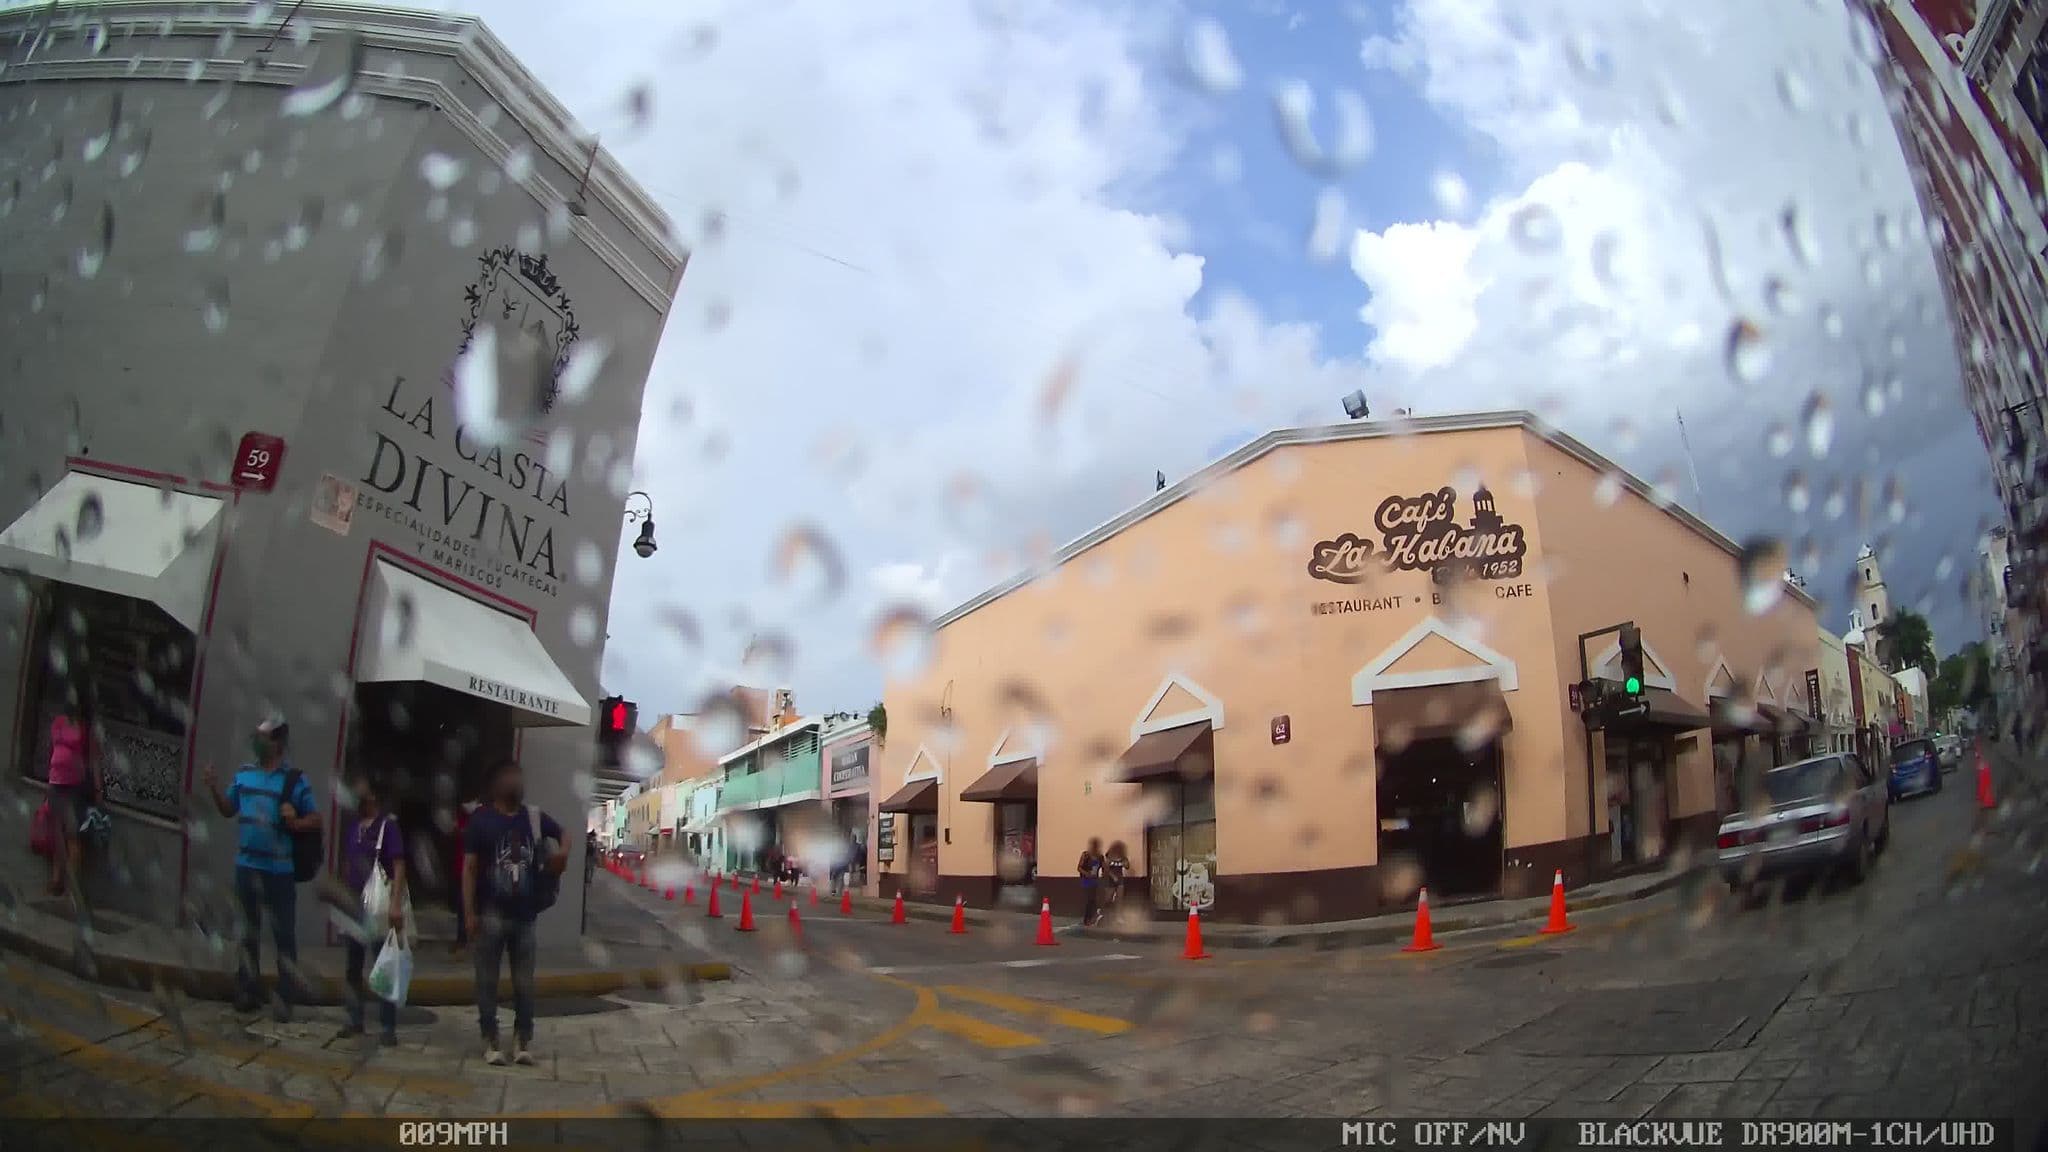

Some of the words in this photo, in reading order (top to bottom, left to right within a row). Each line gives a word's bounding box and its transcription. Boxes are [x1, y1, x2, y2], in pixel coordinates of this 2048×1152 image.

[246, 449, 271, 469] 59
[382, 376, 436, 440] LA
[455, 425, 570, 517] CASTA
[360, 431, 558, 580] DIVINA
[1381, 492, 1449, 533] Café
[433, 549, 502, 589] MARISCOS
[1315, 540, 1369, 577] La
[1384, 529, 1519, 566] Habana
[1481, 559, 1518, 577] 1952
[487, 558, 559, 598] UCATECAS
[1495, 583, 1533, 600] CAFE
[469, 676, 560, 715] RESTAURANTE
